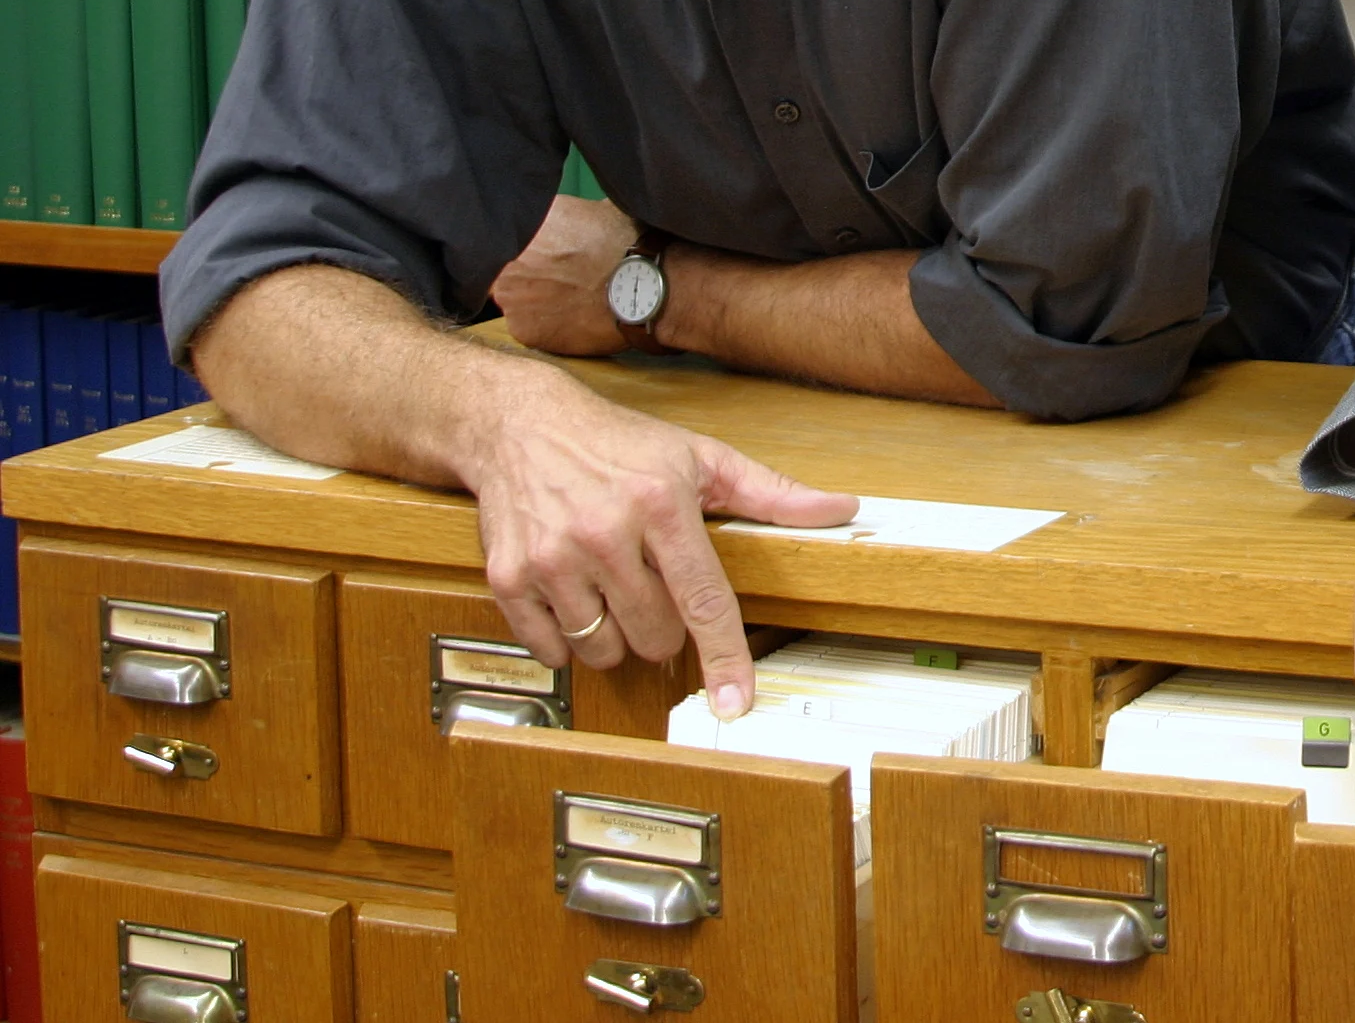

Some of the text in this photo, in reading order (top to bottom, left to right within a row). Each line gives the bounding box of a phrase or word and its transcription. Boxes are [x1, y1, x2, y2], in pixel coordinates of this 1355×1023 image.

[929, 655, 938, 667] F
[803, 702, 812, 716] E
[1318, 721, 1330, 737] G
[600, 815, 677, 835] Autorenkartei
